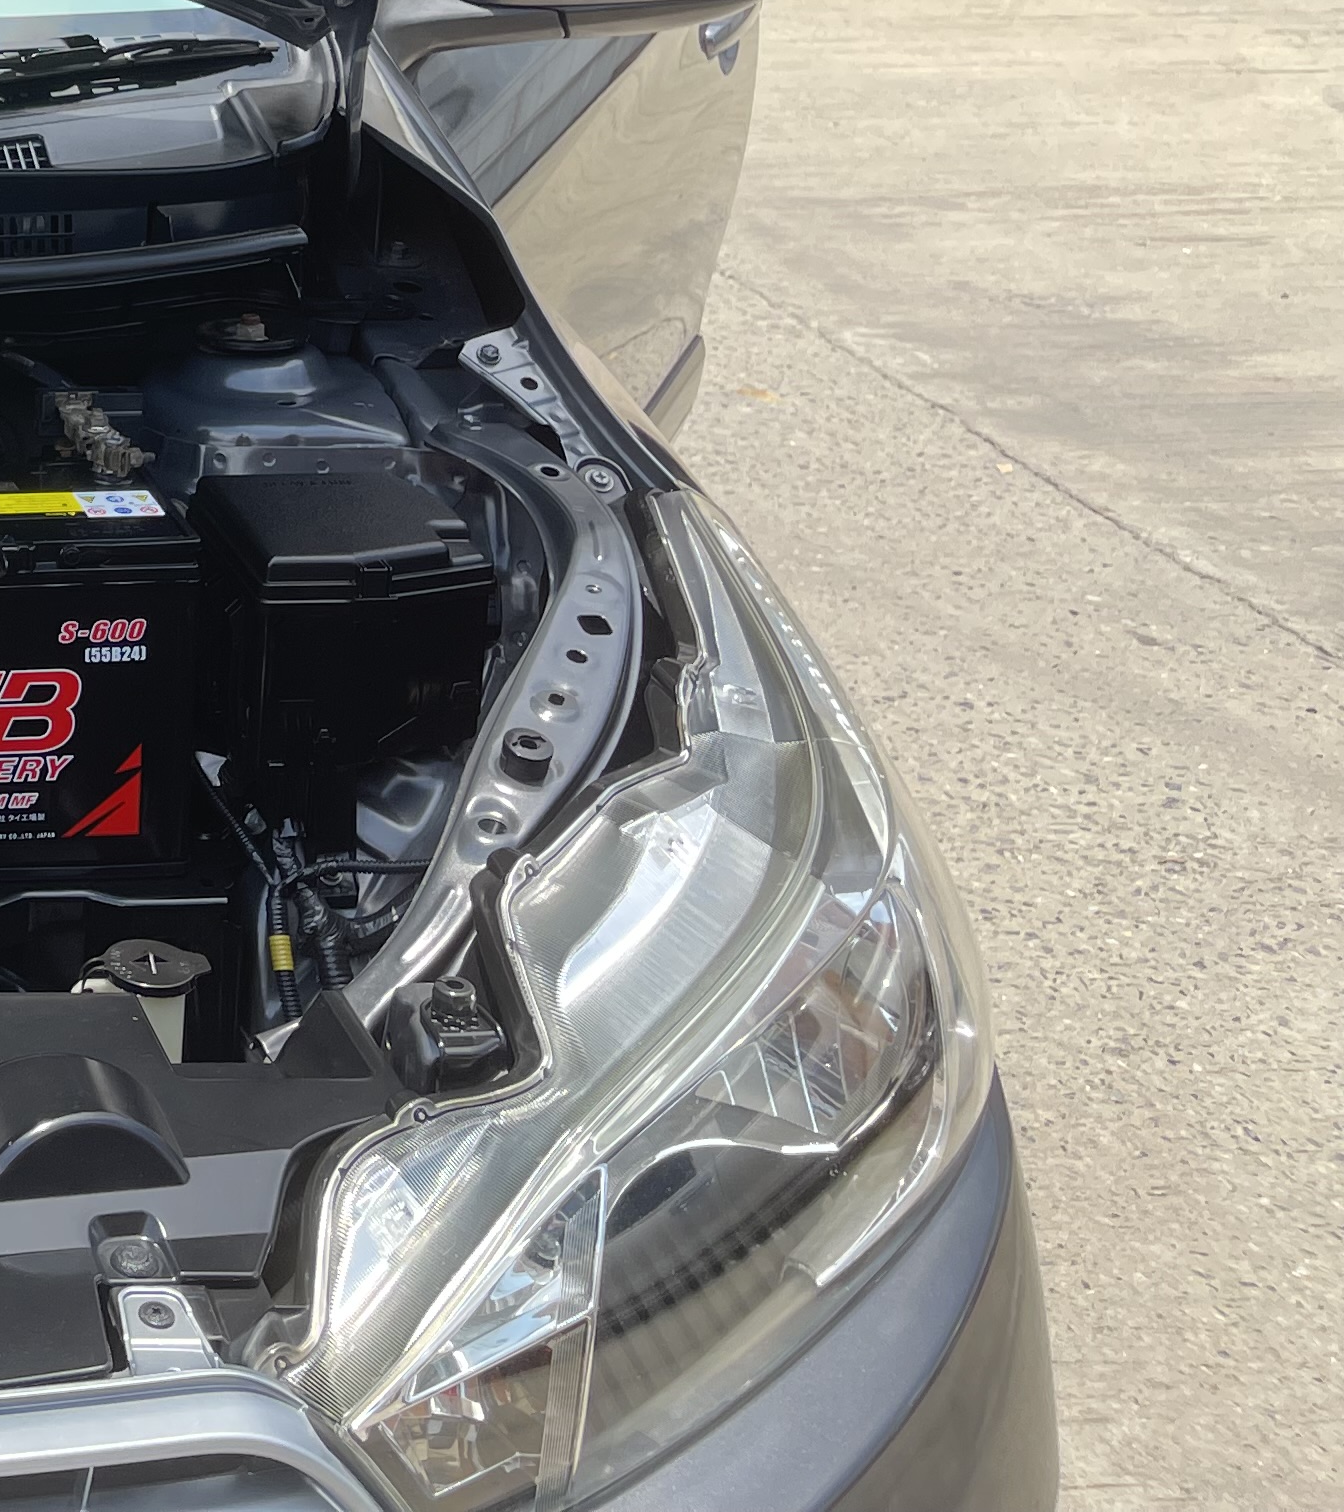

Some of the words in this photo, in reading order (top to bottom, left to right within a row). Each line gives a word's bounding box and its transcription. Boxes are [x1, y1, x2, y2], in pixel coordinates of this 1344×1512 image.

[58, 618, 147, 644] S-600
[84, 645, 147, 663] (55B24)
[8, 792, 40, 809] MF
